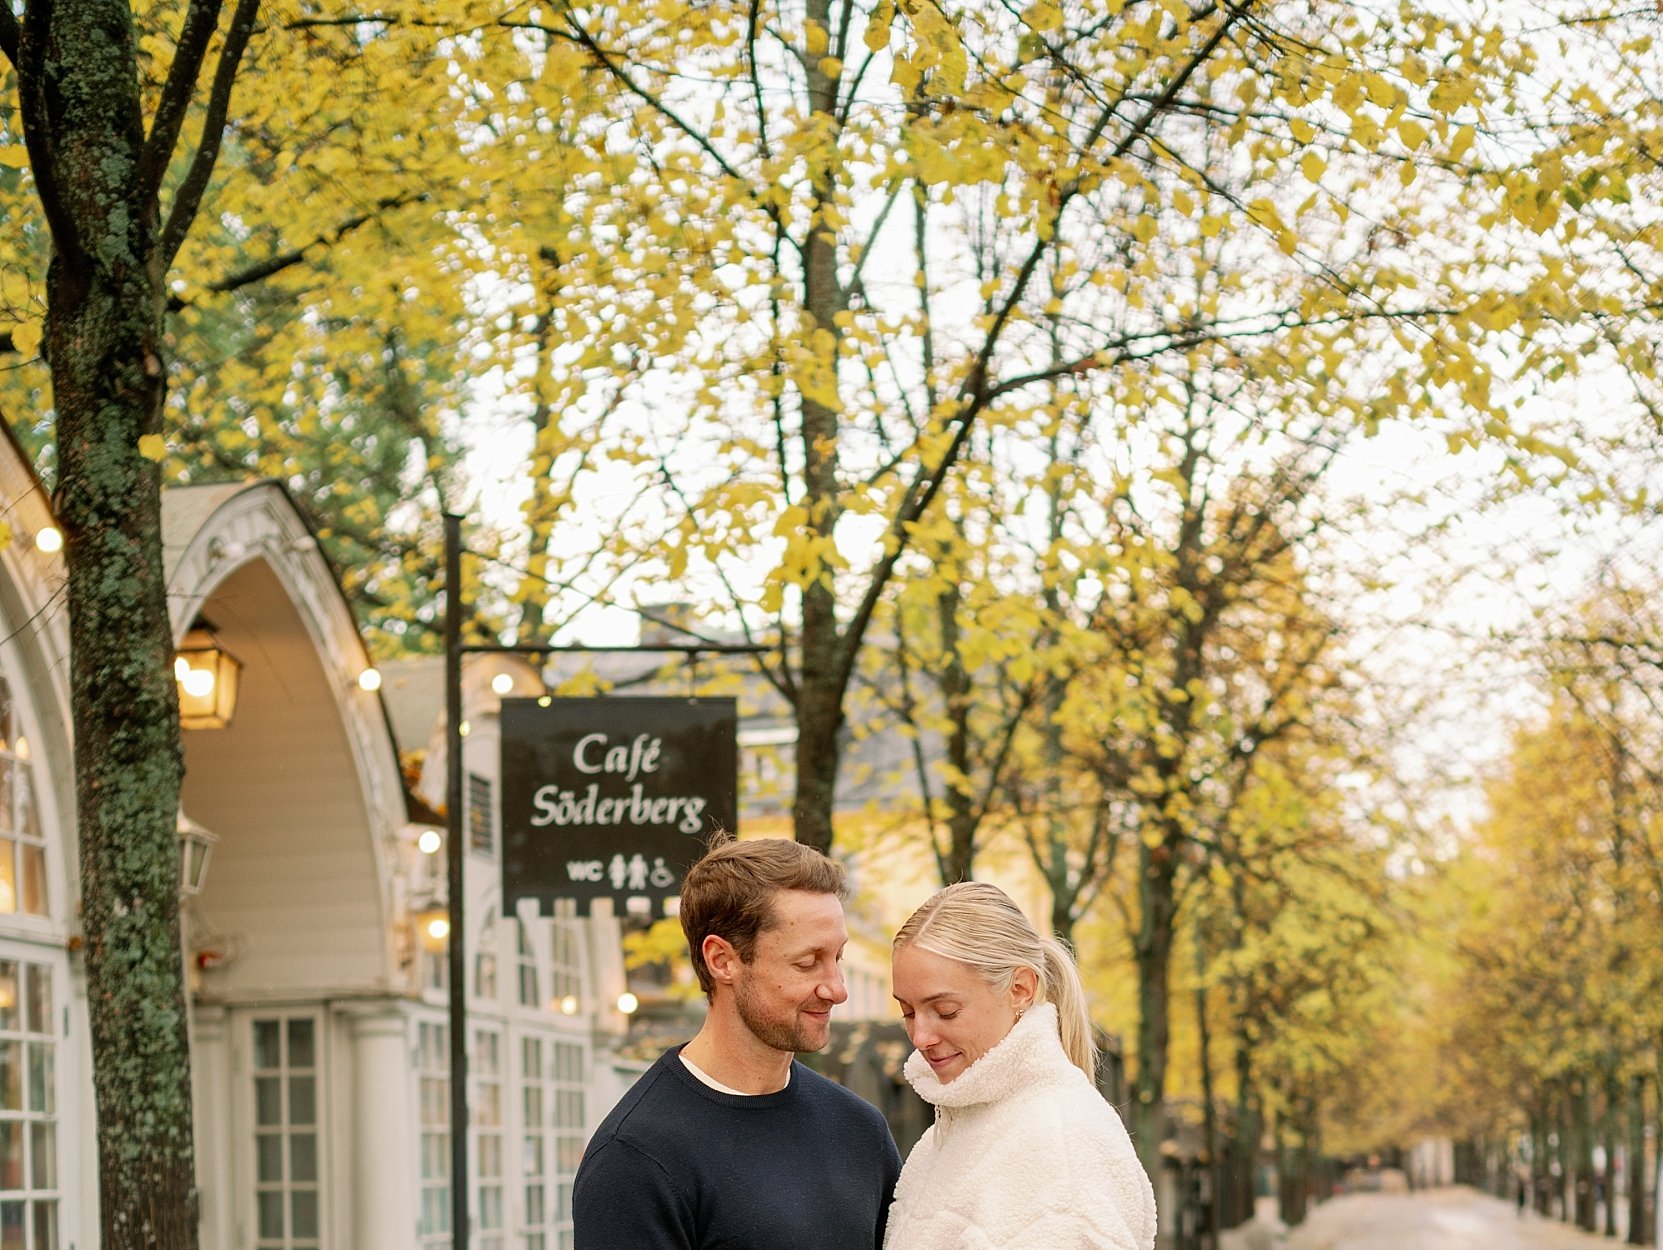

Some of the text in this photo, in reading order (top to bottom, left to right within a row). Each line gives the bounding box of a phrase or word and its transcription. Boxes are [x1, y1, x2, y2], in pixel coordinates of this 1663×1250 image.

[573, 733, 661, 782] Café
[531, 783, 706, 834] Söderberg
[566, 860, 603, 882] WC
